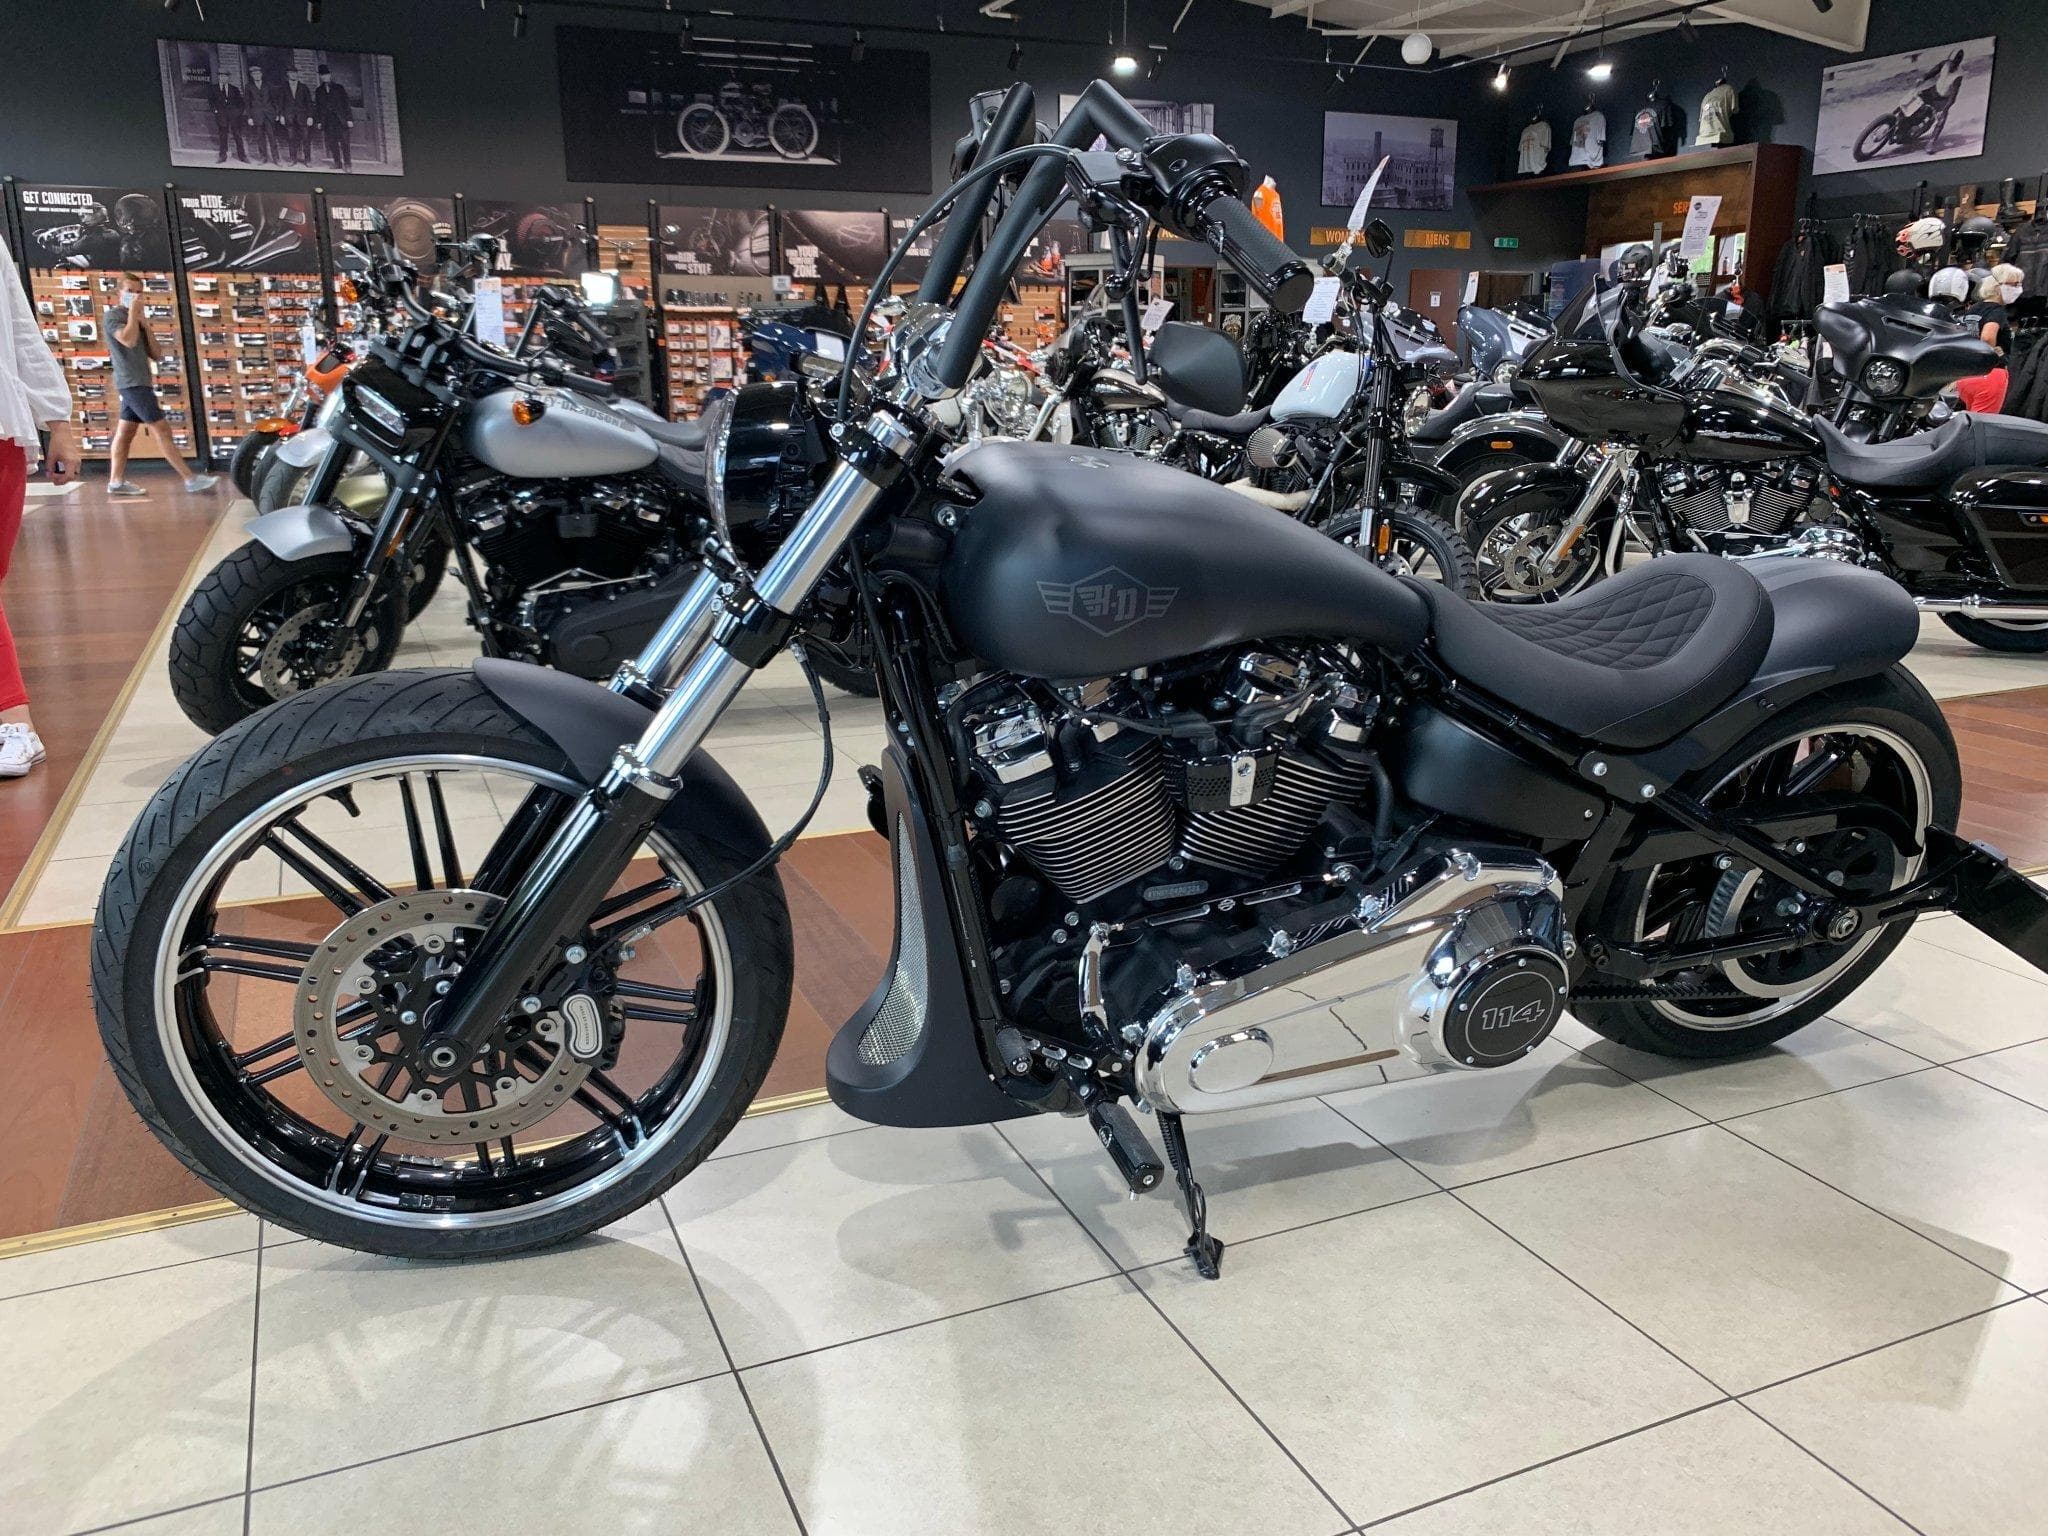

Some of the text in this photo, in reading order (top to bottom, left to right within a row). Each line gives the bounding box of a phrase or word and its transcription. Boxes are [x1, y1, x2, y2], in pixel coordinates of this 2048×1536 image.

[22, 190, 93, 206] GET CONNECTED
[181, 197, 200, 208] YOUR
[193, 208, 211, 219] YOUR
[331, 207, 369, 220] NEW GEA
[1672, 201, 1690, 214] SER
[341, 220, 363, 231] SAME
[1325, 229, 1366, 243] WOMNS
[1425, 233, 1450, 246] MENS
[1482, 999, 1546, 1030] 114
